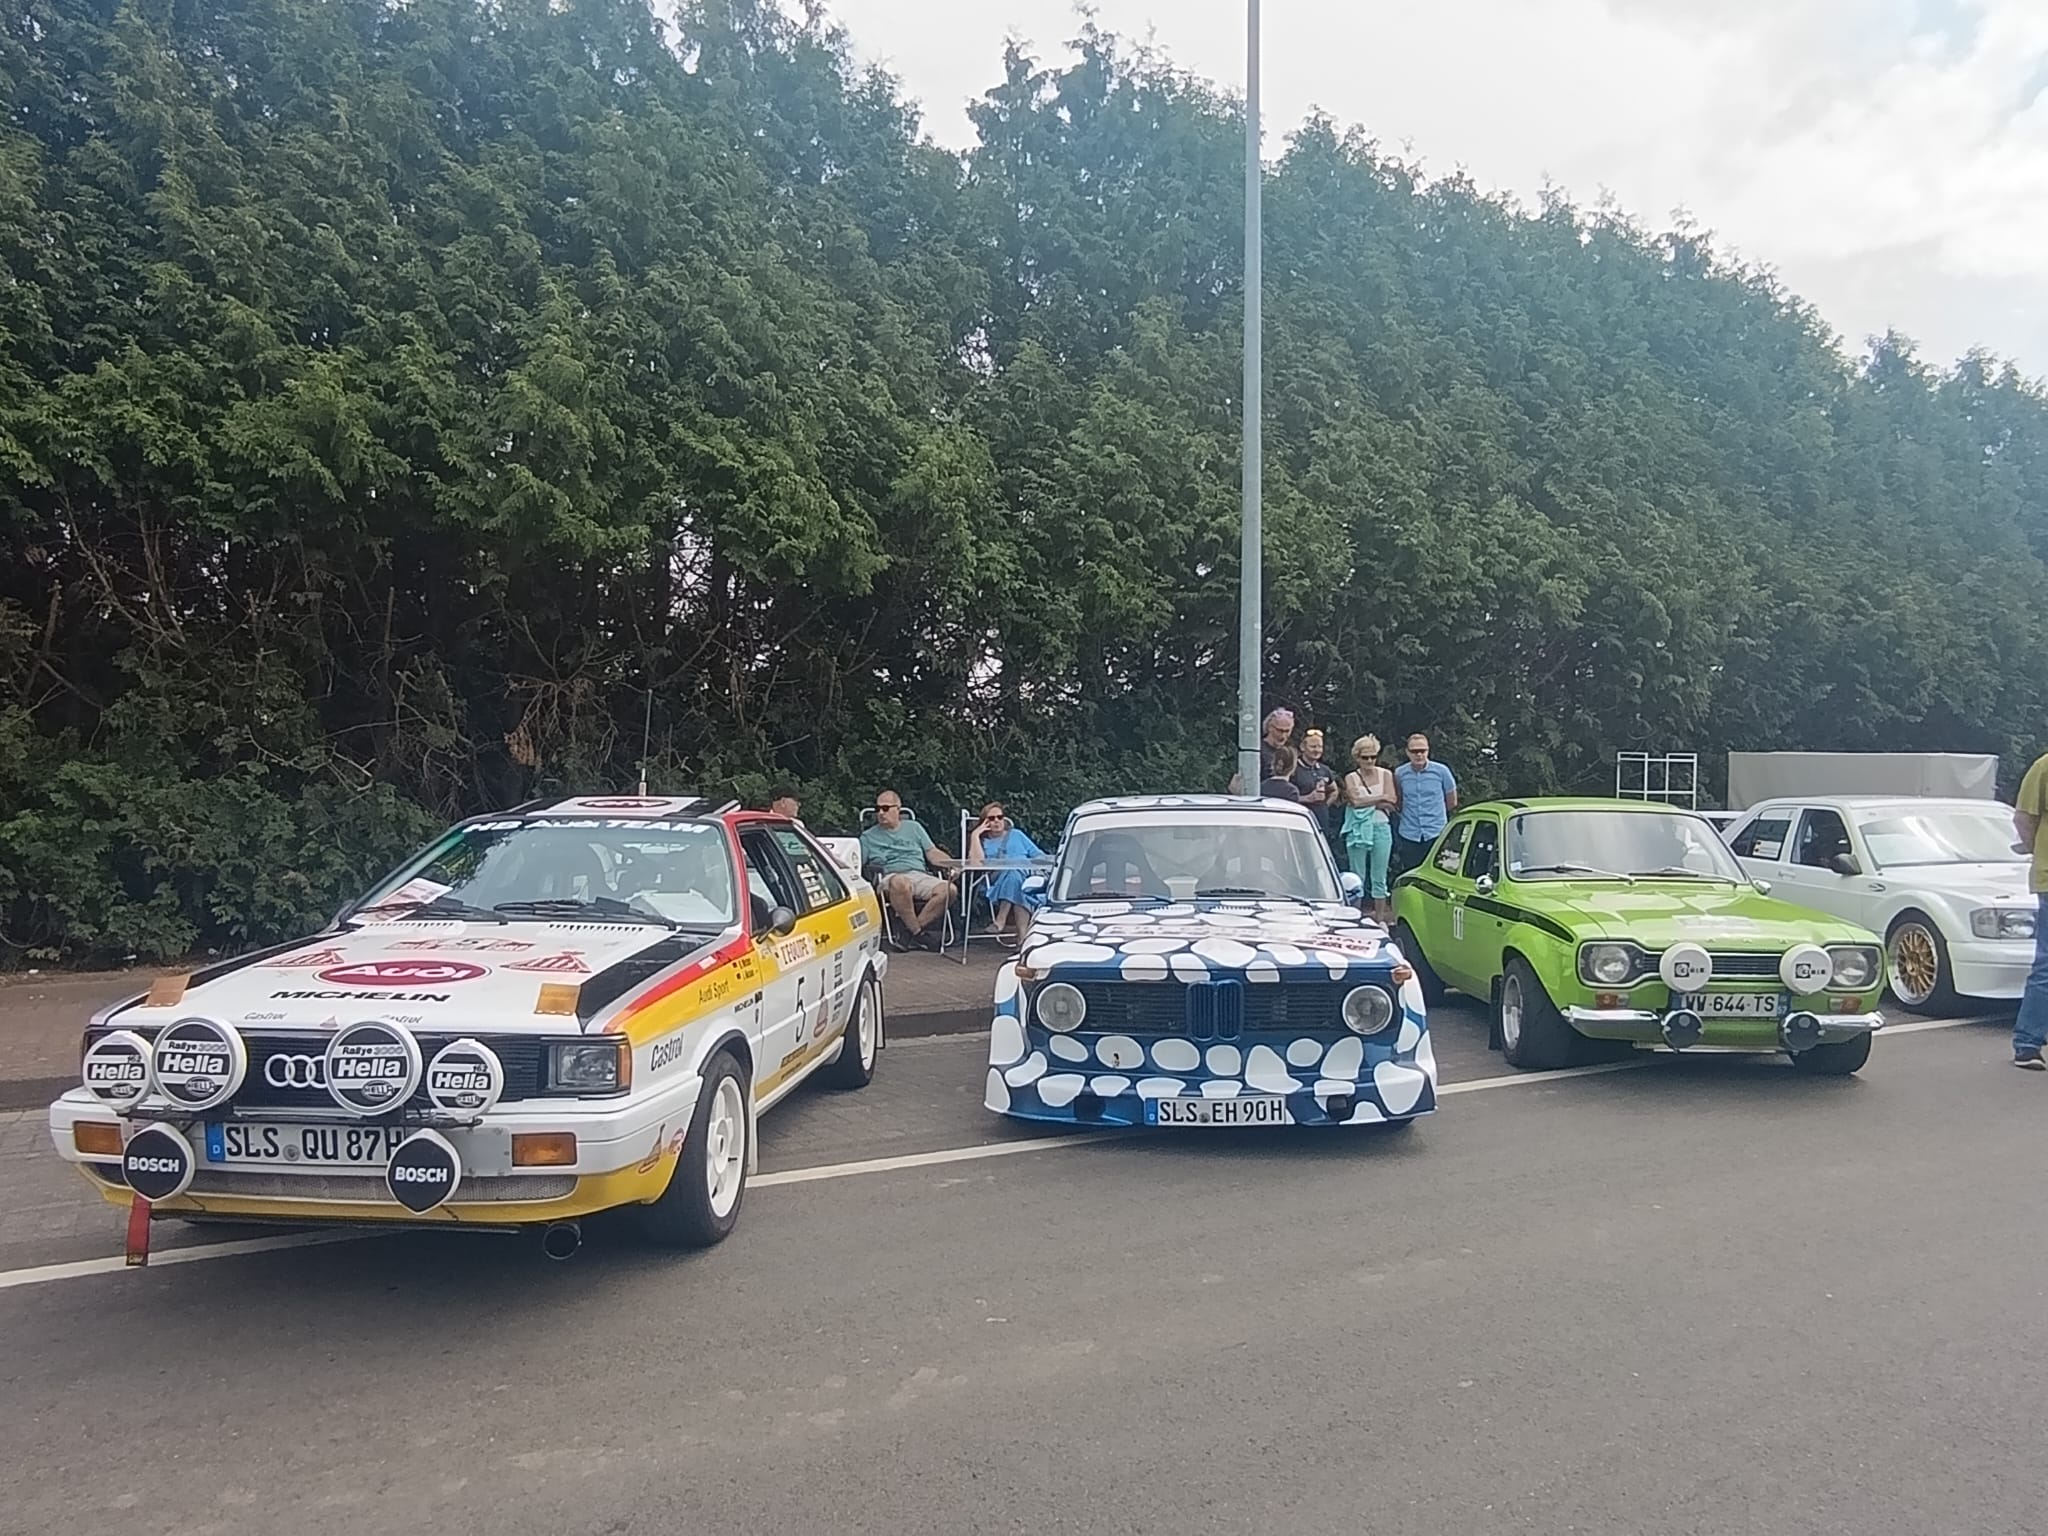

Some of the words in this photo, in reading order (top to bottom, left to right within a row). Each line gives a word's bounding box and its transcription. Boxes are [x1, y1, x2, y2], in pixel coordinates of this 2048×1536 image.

[606, 819, 711, 833] TEAM
[328, 965, 473, 979] Audi
[269, 991, 451, 1002] MICHELIN
[168, 1041, 198, 1052] Rallye
[342, 1046, 373, 1057] Rallye
[650, 1032, 684, 1072] Castrol
[162, 1053, 225, 1074] Hella
[337, 1058, 401, 1077] Hella
[90, 1064, 143, 1080] Hella
[434, 1072, 490, 1089] Hella
[1159, 1101, 1198, 1122] SLS
[1212, 1102, 1237, 1122] EH
[1243, 1100, 1283, 1122] 90H
[225, 1126, 280, 1158] SLS
[302, 1128, 339, 1160] QU
[128, 1157, 180, 1173] BOSCH
[394, 1167, 448, 1182] BOSCH
